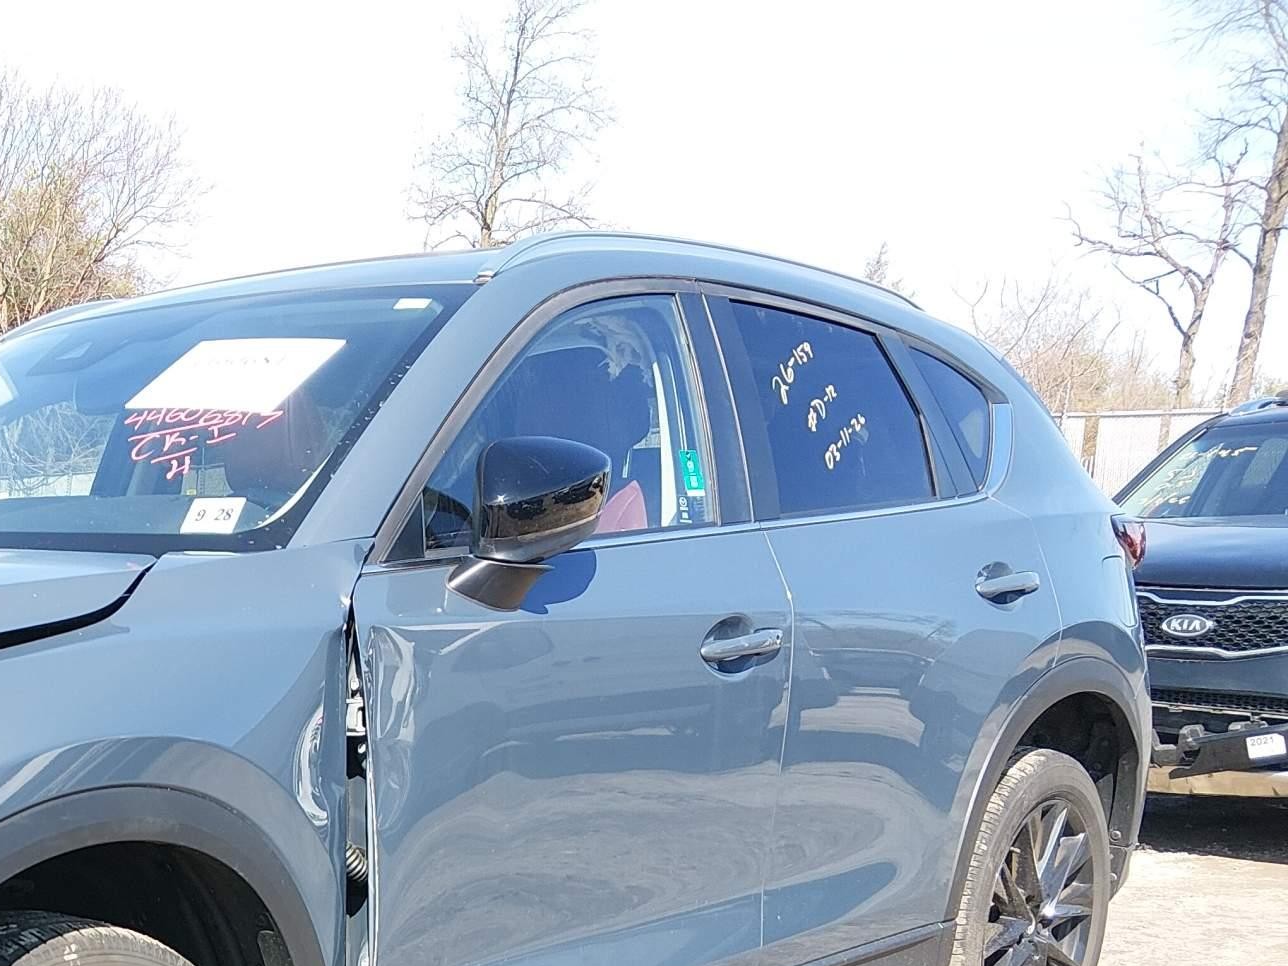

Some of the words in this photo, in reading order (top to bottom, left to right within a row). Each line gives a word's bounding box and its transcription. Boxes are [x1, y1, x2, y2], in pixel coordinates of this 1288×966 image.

[772, 341, 814, 405] 26-159
[824, 413, 867, 470] 03-11-26
[194, 508, 208, 522] 9
[214, 507, 234, 521] 28
[1170, 618, 1201, 631] KIA
